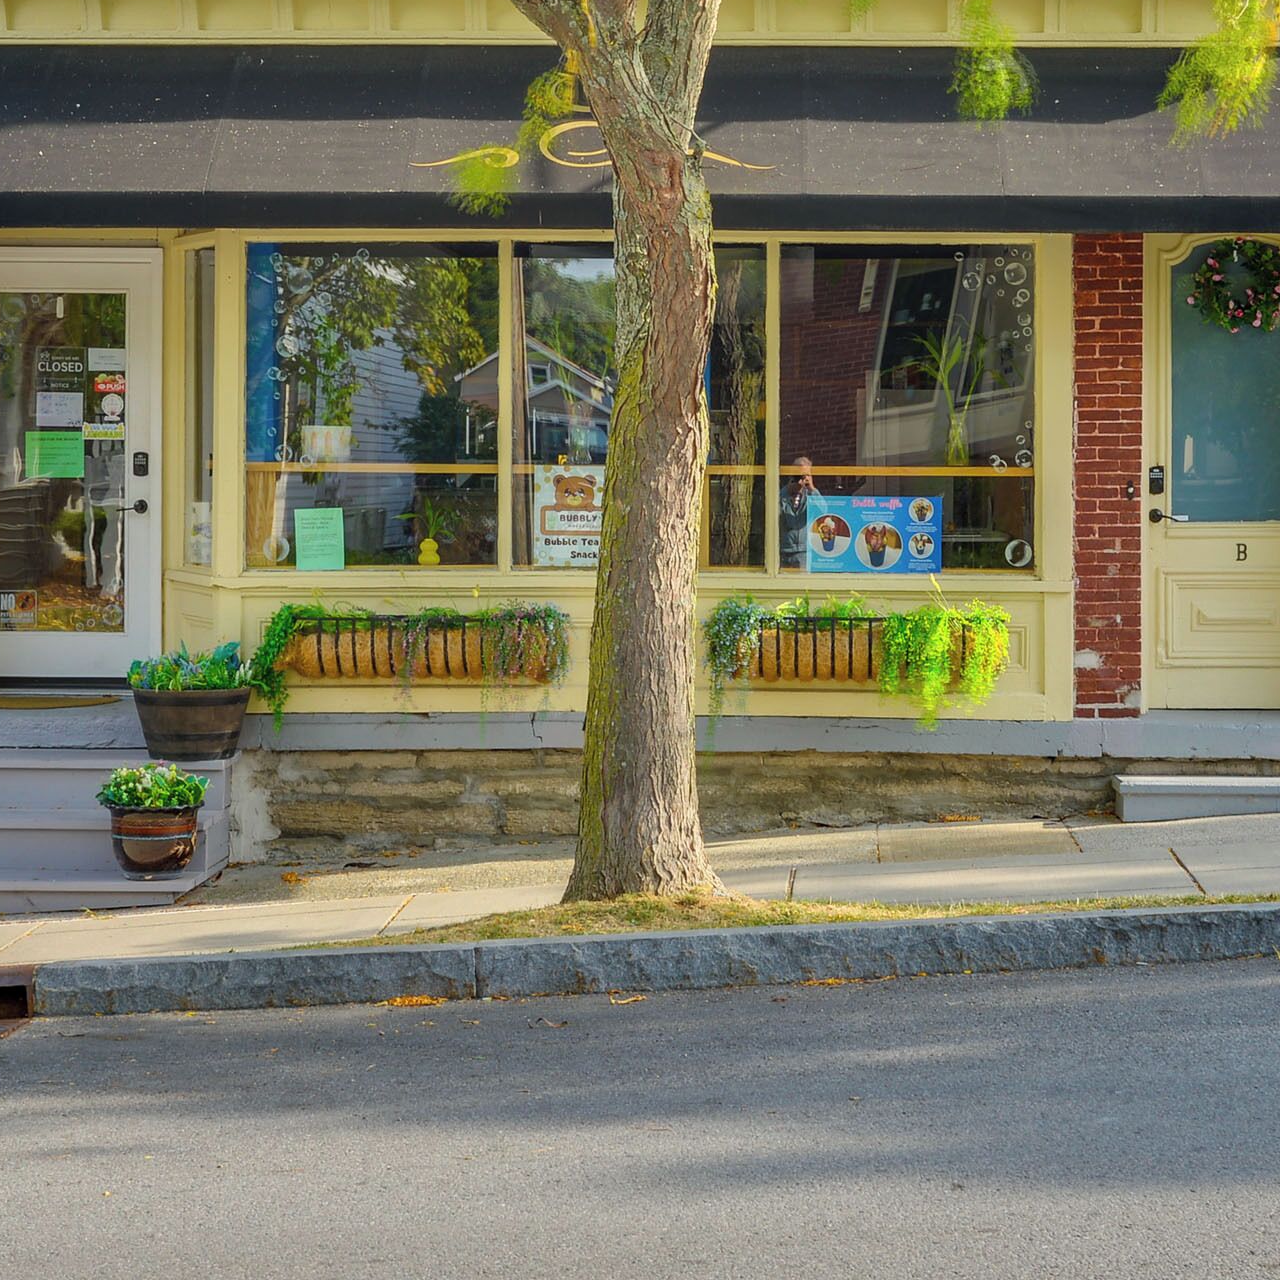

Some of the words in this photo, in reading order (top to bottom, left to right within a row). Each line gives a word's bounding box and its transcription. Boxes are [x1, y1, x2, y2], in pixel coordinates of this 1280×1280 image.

[38, 361, 83, 373] CLOSED
[559, 514, 597, 522] BUBBLY
[544, 538, 578, 546] Bubble
[581, 538, 600, 546] Tea
[1235, 543, 1248, 561] B
[0, 593, 16, 611] NO
